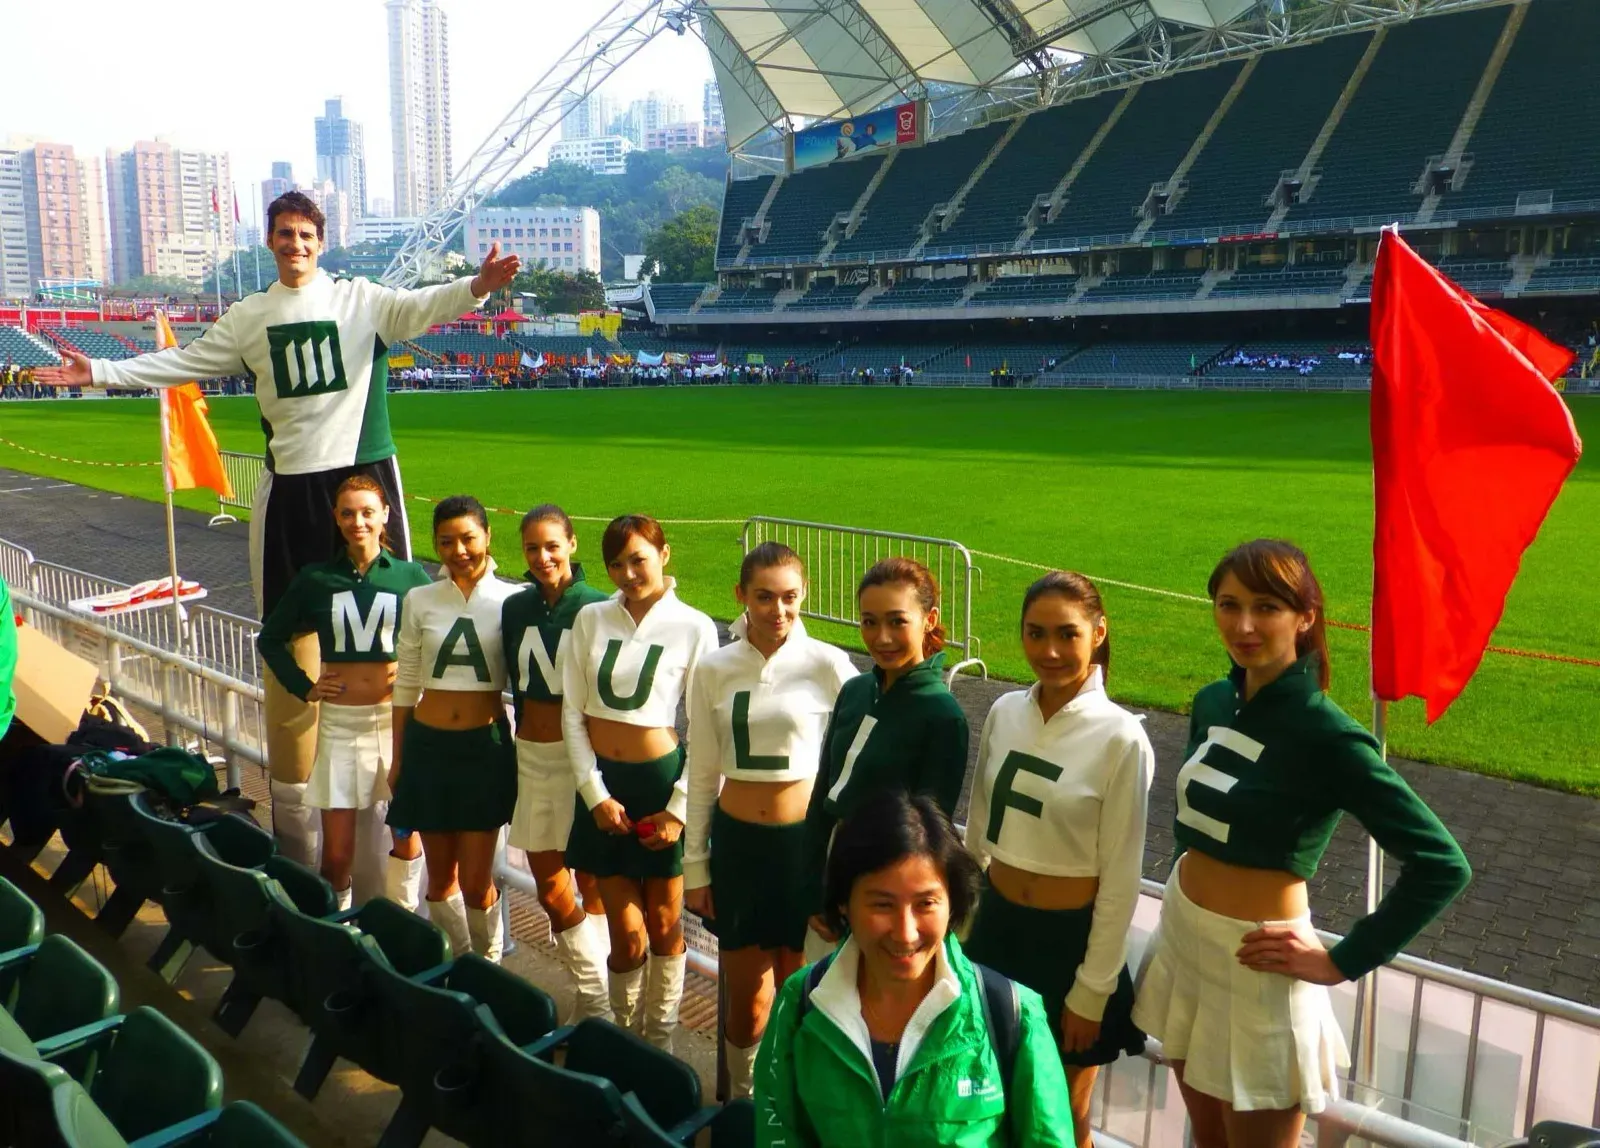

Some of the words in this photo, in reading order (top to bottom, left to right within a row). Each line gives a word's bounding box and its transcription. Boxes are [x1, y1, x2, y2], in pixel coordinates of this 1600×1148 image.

[332, 590, 397, 653] M
[432, 617, 491, 683] A
[518, 627, 572, 695] N
[597, 639, 663, 711] U
[731, 690, 790, 770] L
[827, 714, 878, 802] I
[986, 749, 1064, 845] F
[1176, 725, 1266, 844] E
